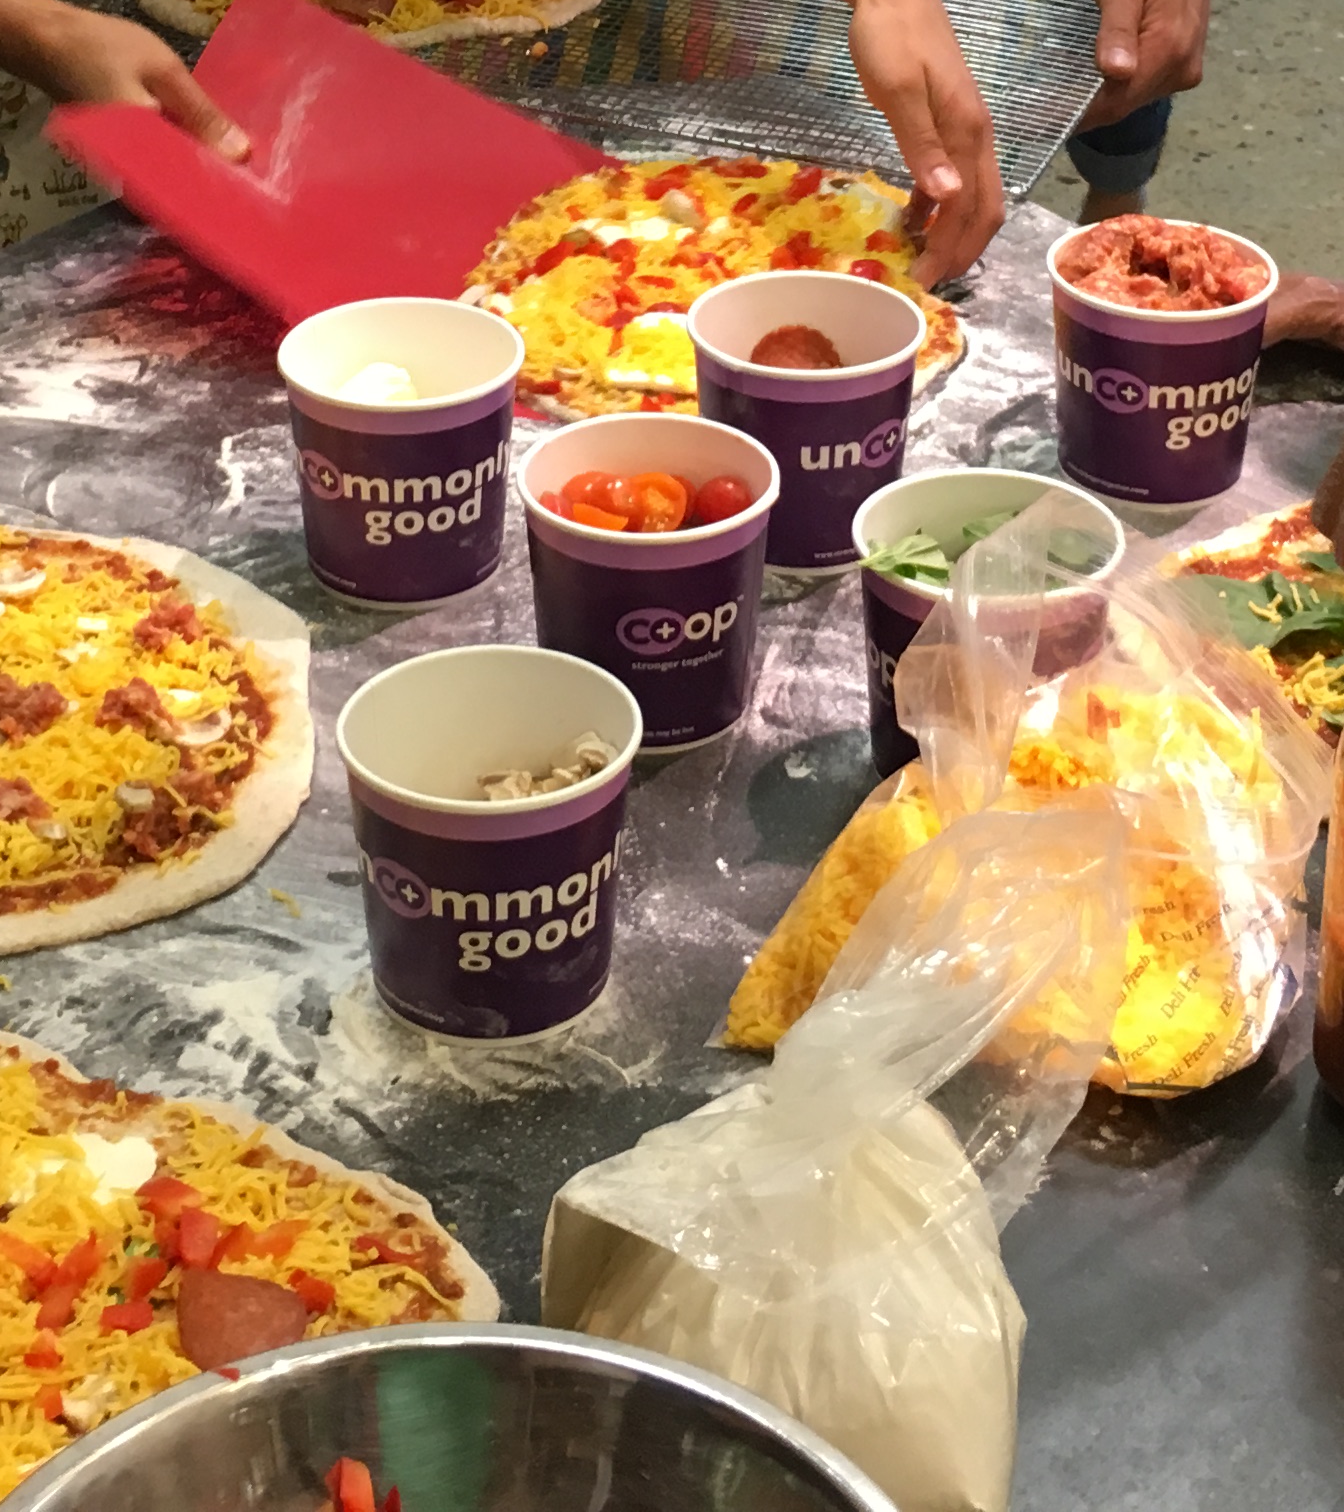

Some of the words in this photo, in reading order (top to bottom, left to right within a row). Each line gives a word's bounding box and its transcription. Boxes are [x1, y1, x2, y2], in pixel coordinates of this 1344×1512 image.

[364, 487, 484, 546] good
[458, 891, 598, 972] good
[1160, 988, 1187, 1019] Deli
[1182, 1029, 1217, 1069] Fresh
